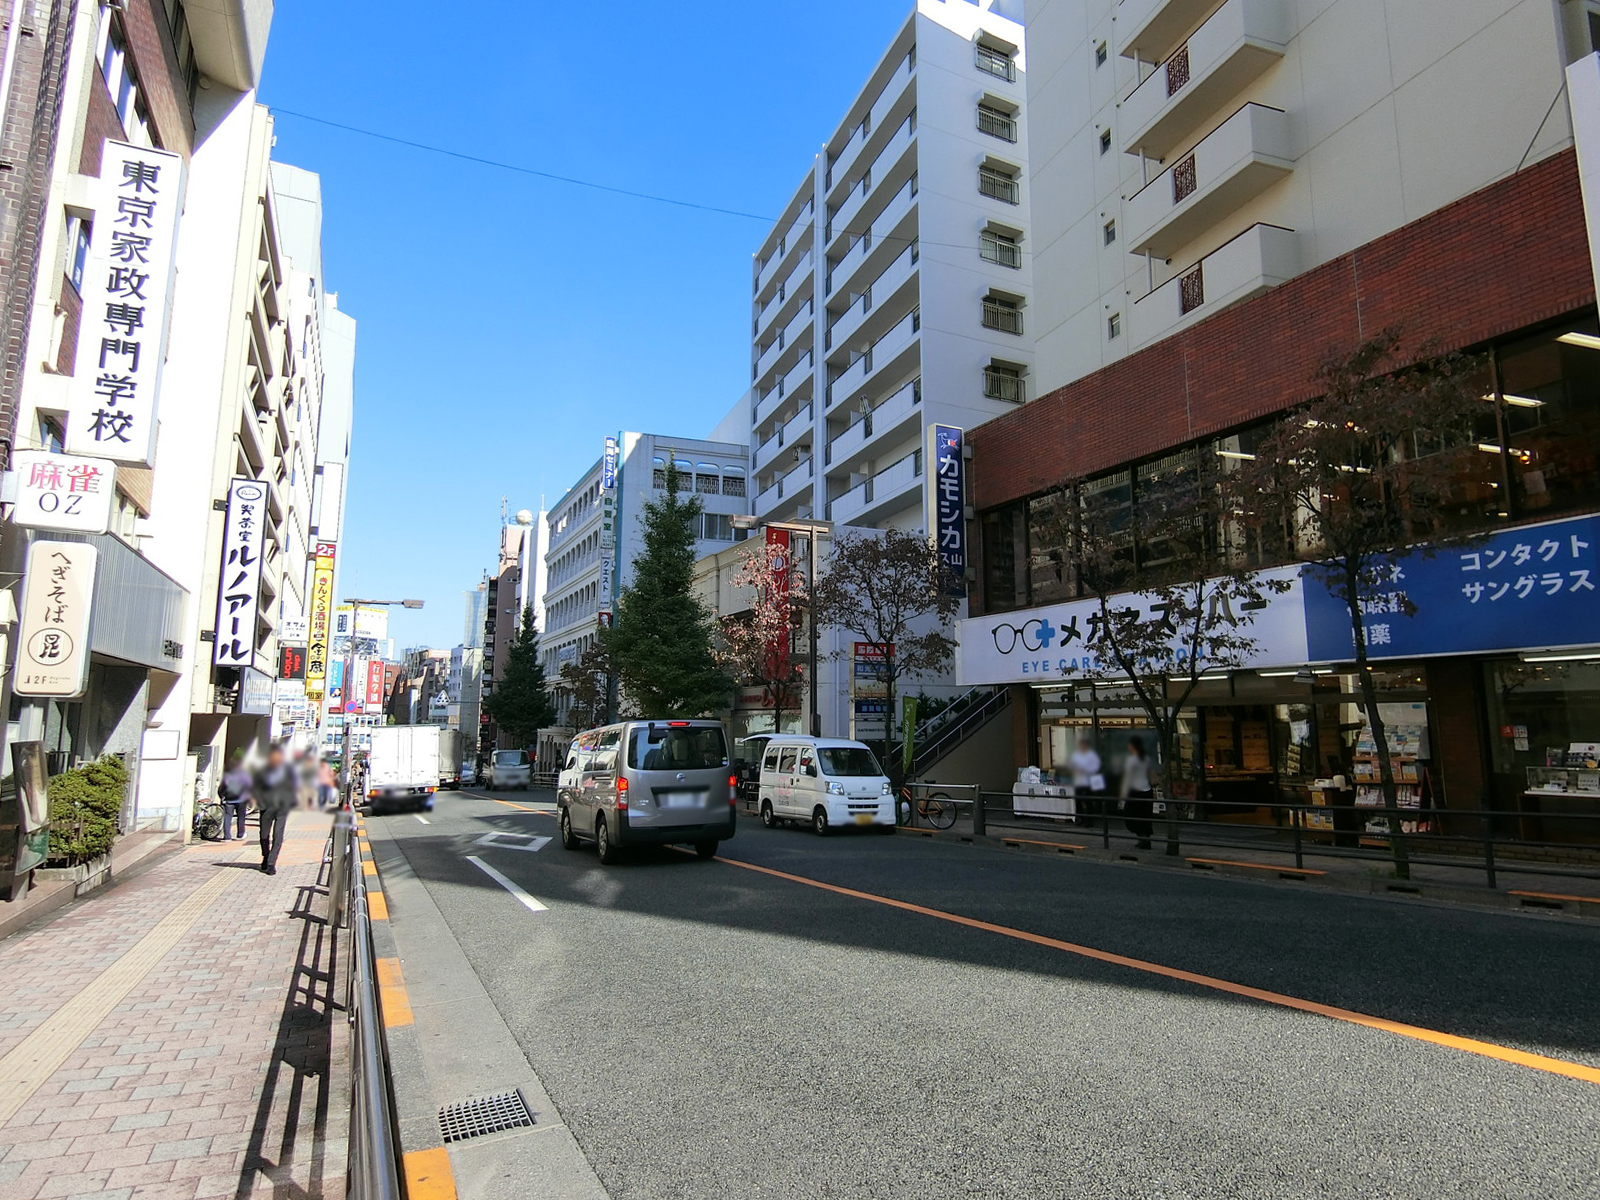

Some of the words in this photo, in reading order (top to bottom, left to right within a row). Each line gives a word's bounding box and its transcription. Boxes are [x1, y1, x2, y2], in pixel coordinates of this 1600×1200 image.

[87, 159, 162, 444] 東京家政専門学校
[27, 461, 104, 494] 麻雀
[38, 492, 83, 515] OZ
[938, 454, 961, 549] カモシカ
[238, 504, 255, 542] 喫茶室
[317, 545, 335, 557] 2F
[1460, 534, 1589, 572] コンタクト
[44, 551, 73, 623] へぎそば
[602, 560, 610, 592] クエスト
[1461, 569, 1595, 603] サングラス
[218, 545, 259, 660] ルノアール
[39, 634, 61, 659] 昆
[284, 647, 293, 679] union
[34, 675, 48, 684] 2F
[1022, 660, 1050, 673] EYE
